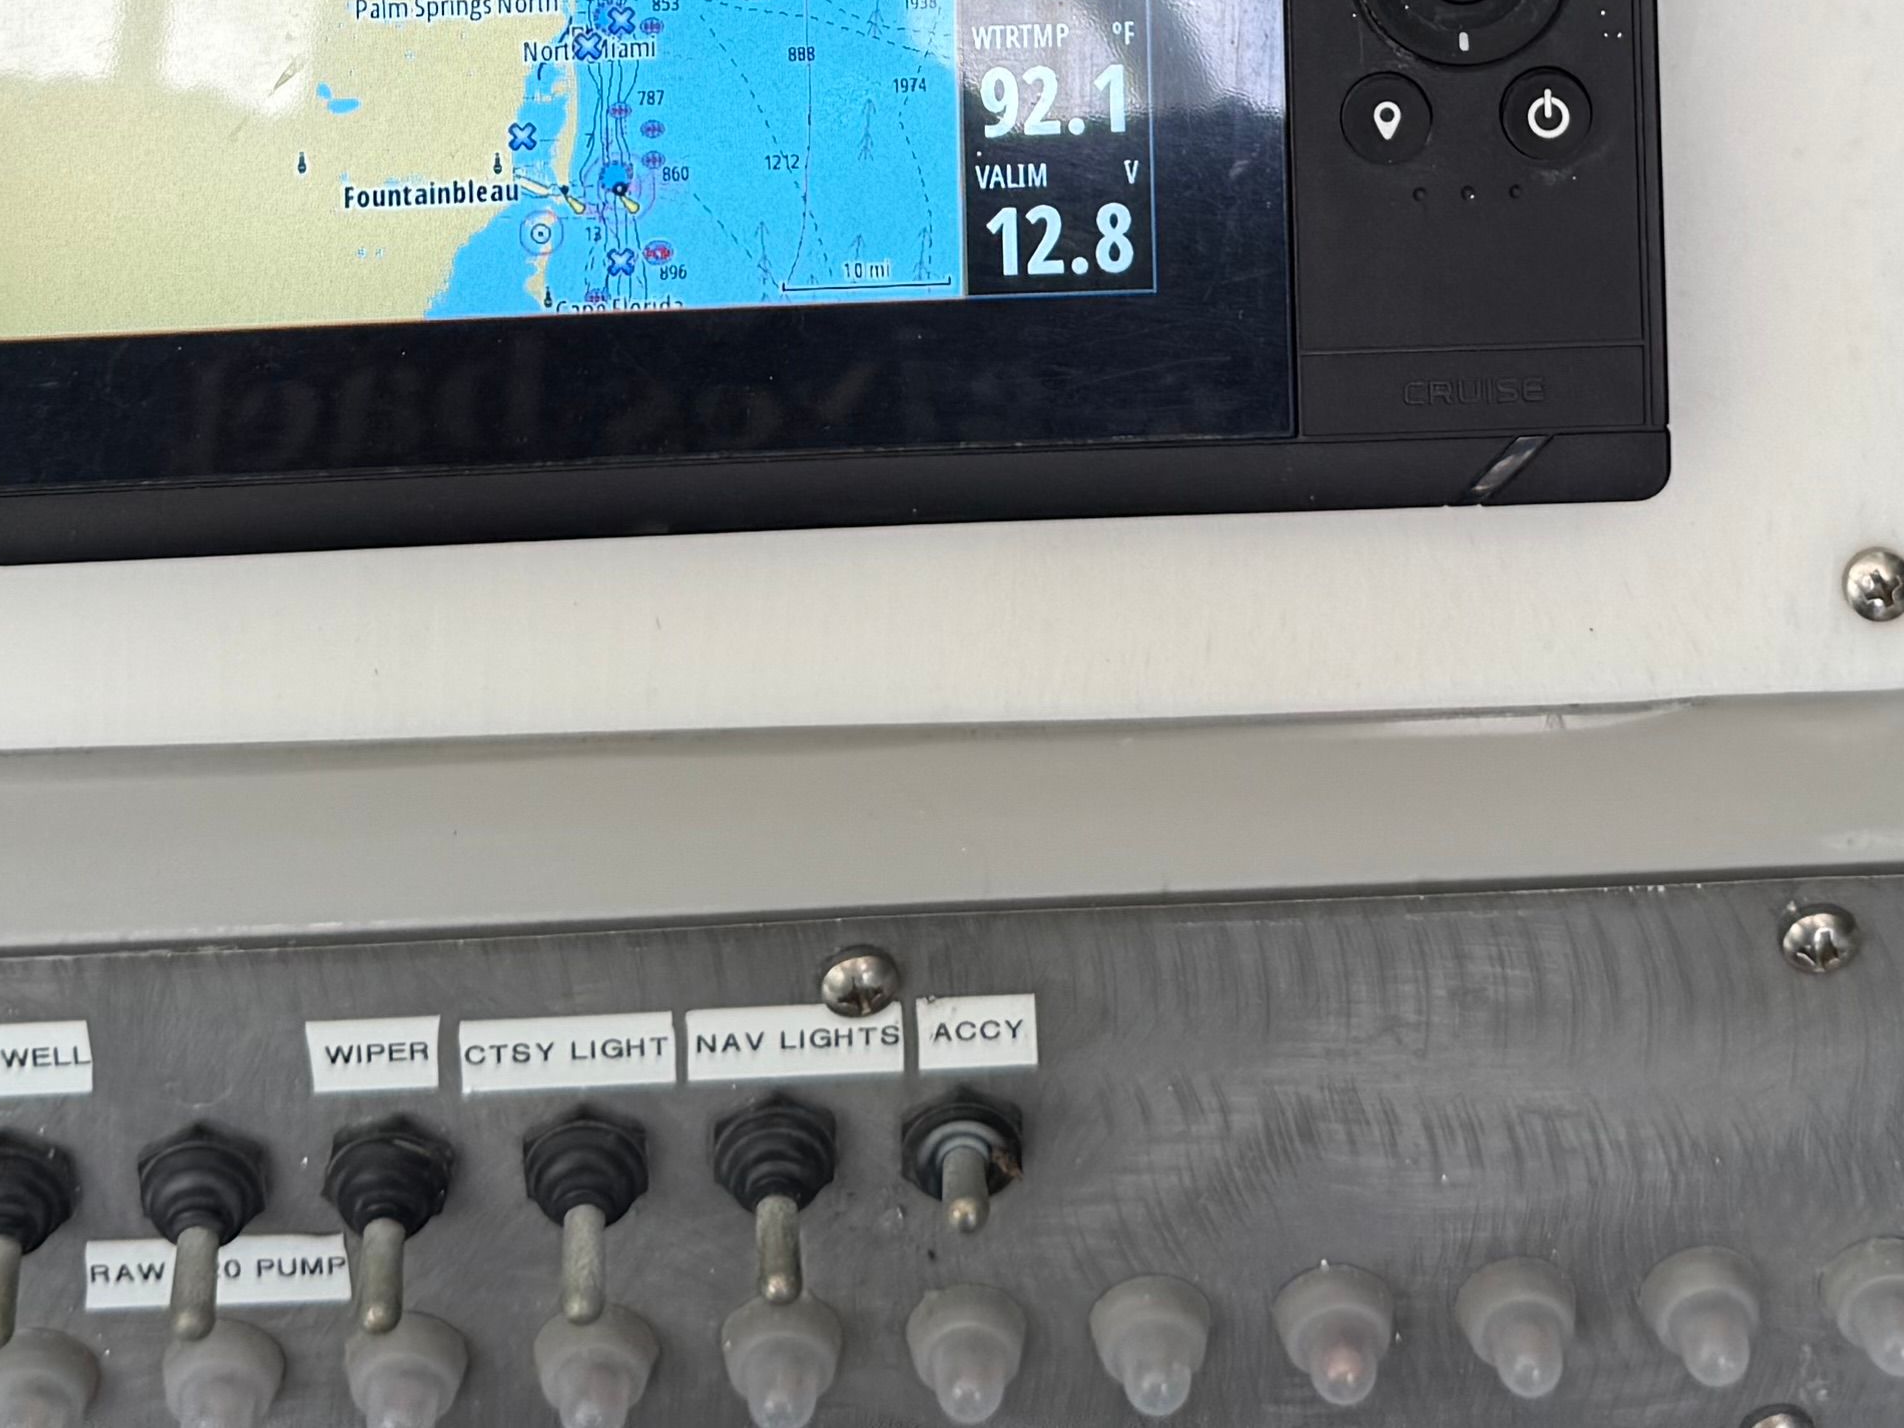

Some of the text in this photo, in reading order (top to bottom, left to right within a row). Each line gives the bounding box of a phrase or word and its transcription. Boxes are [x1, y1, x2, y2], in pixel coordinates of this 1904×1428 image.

[972, 24, 1070, 50] WTRTMP
[523, 42, 580, 62] Nort
[638, 90, 664, 105] 787
[893, 77, 927, 93] 1974
[980, 64, 1128, 139] 92.1
[662, 166, 689, 181] 860
[975, 159, 1139, 189] VALIM V
[344, 180, 519, 209] Fountainbleau
[585, 226, 601, 242] 13
[986, 202, 1134, 277] 12.8
[843, 260, 890, 279] 10 mi
[1403, 376, 1546, 407] CRUISE
[696, 1024, 900, 1054] NAV LIGHTS
[933, 1019, 1025, 1042] ACCY
[326, 1040, 430, 1065] WIPER
[465, 1035, 669, 1066] CTSY LIGHT
[90, 1262, 165, 1284] RAW
[257, 1256, 346, 1278] PUMP
